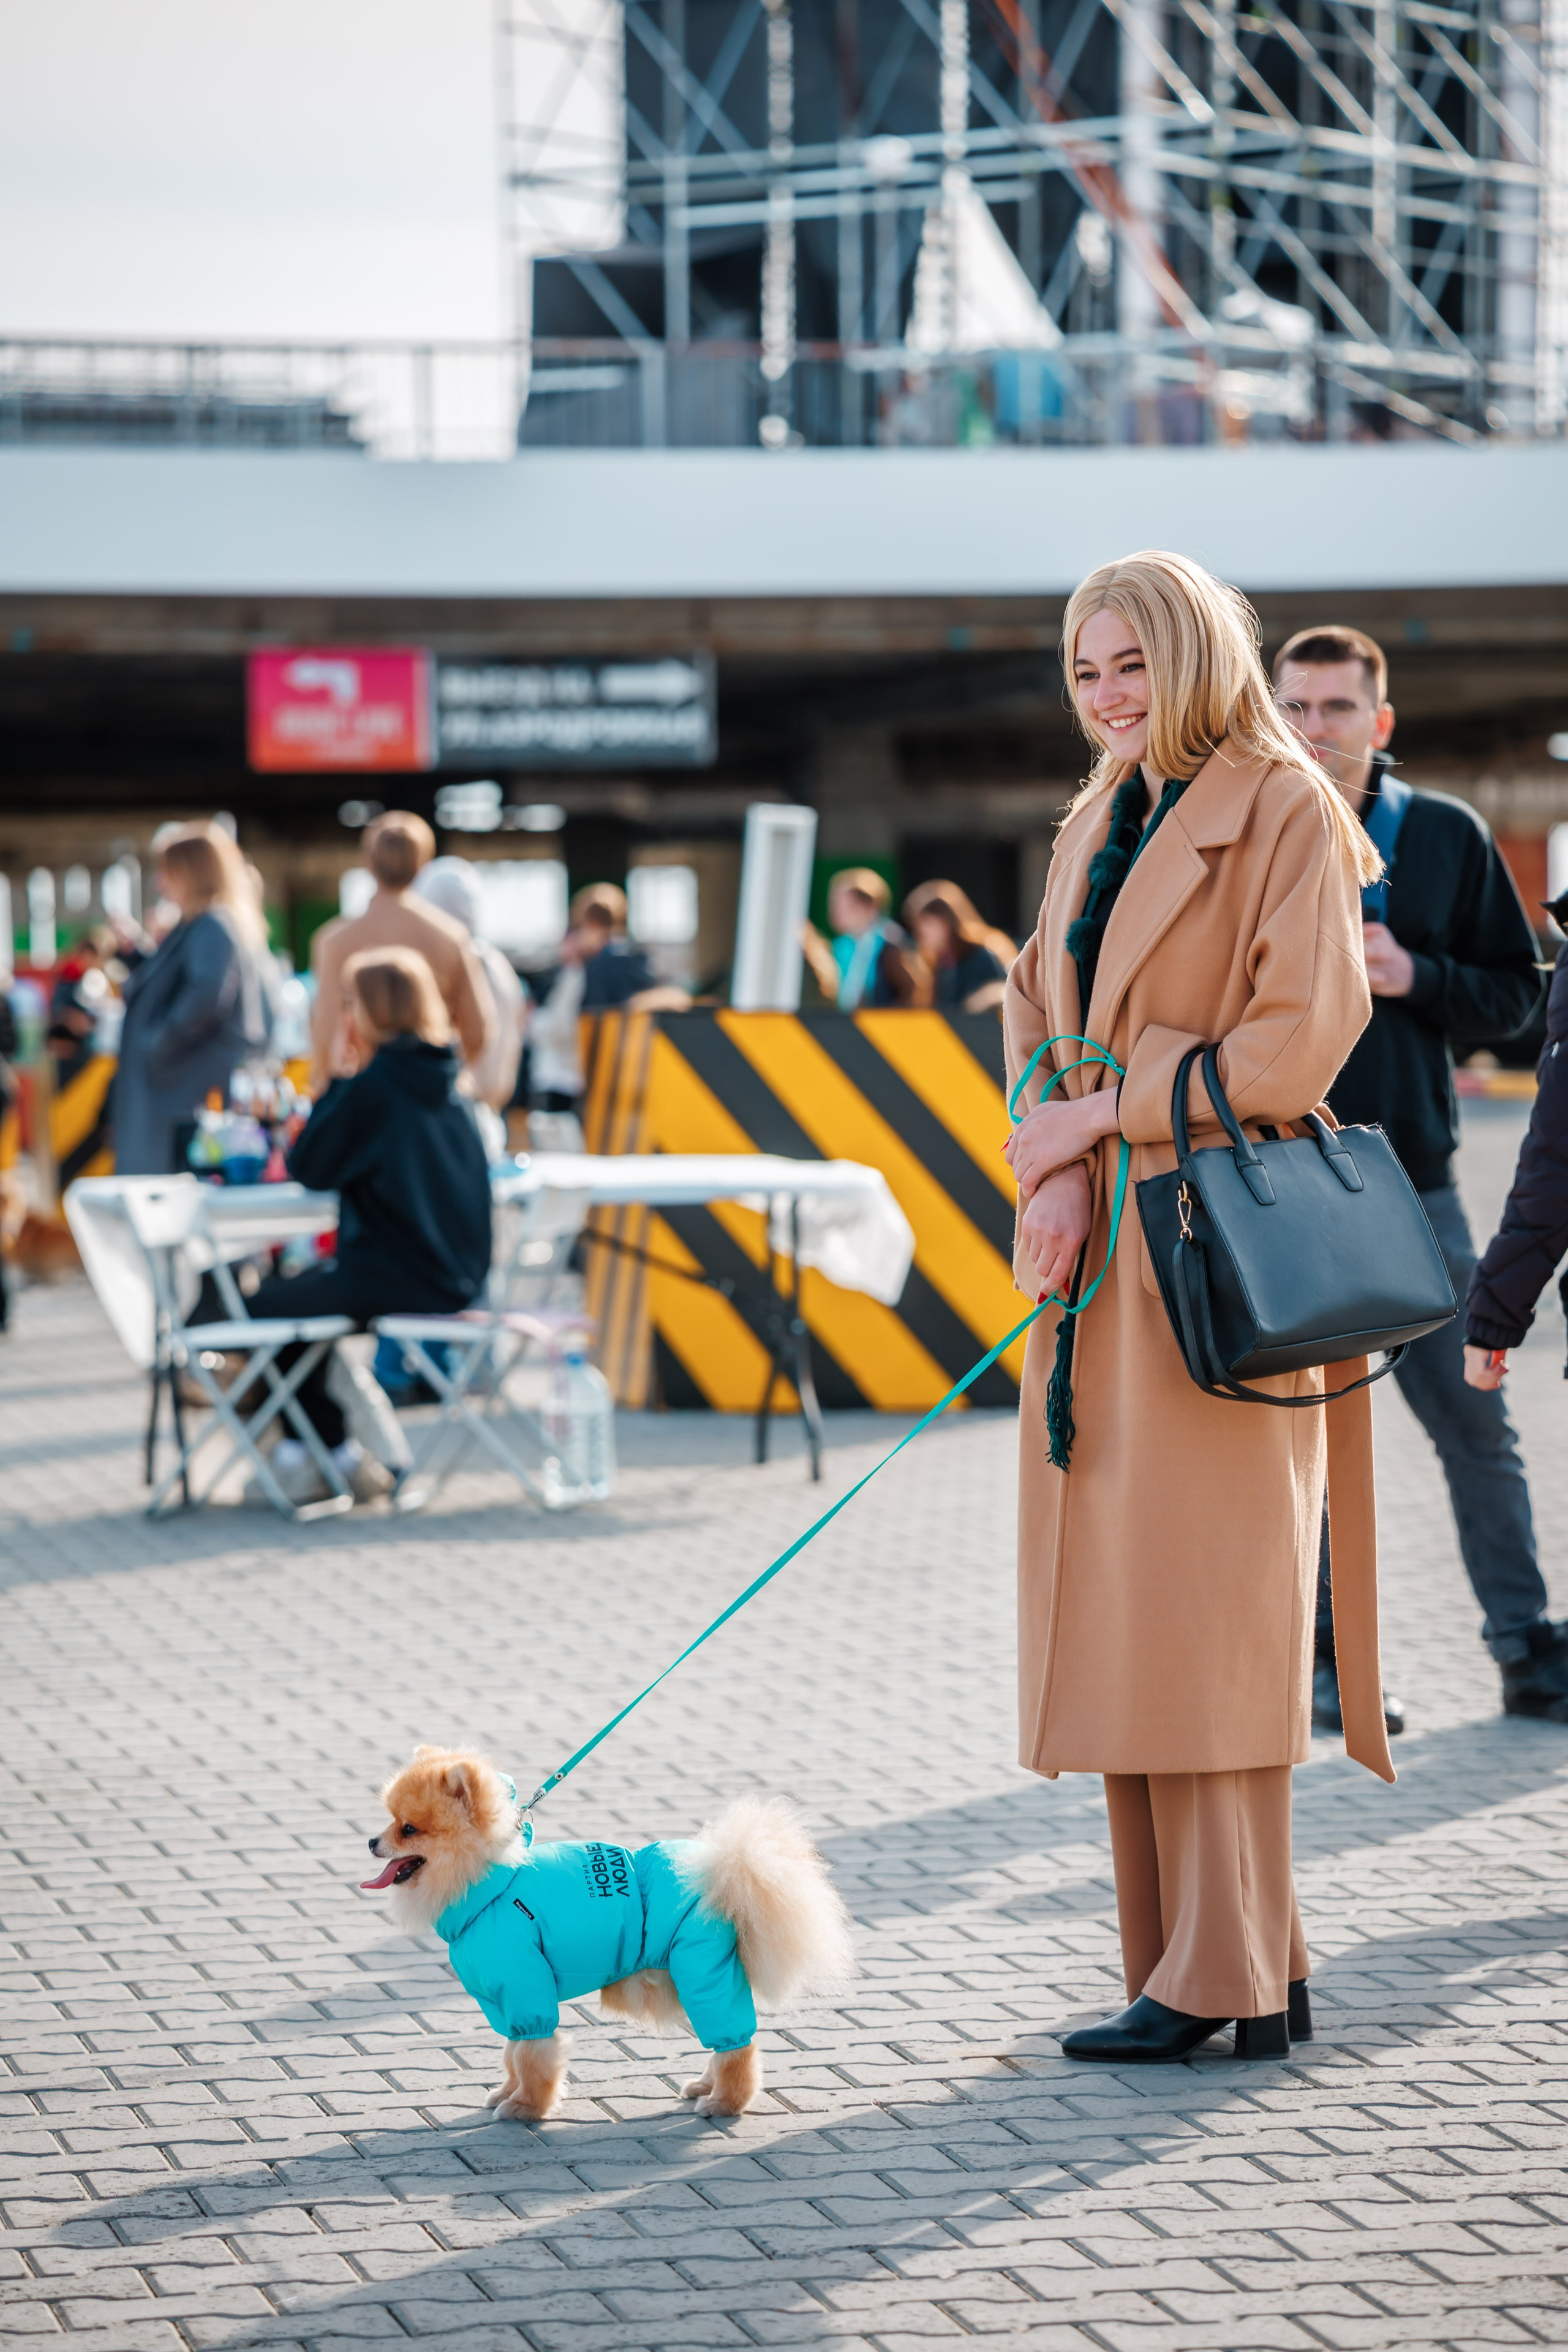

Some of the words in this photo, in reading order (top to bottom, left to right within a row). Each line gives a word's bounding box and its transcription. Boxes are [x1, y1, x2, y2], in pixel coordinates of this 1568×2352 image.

[582, 1864, 595, 1898] ПАРТИЯ
[586, 1843, 612, 1898] НОВЫЕ
[606, 1847, 630, 1898] ЛЮДИ
